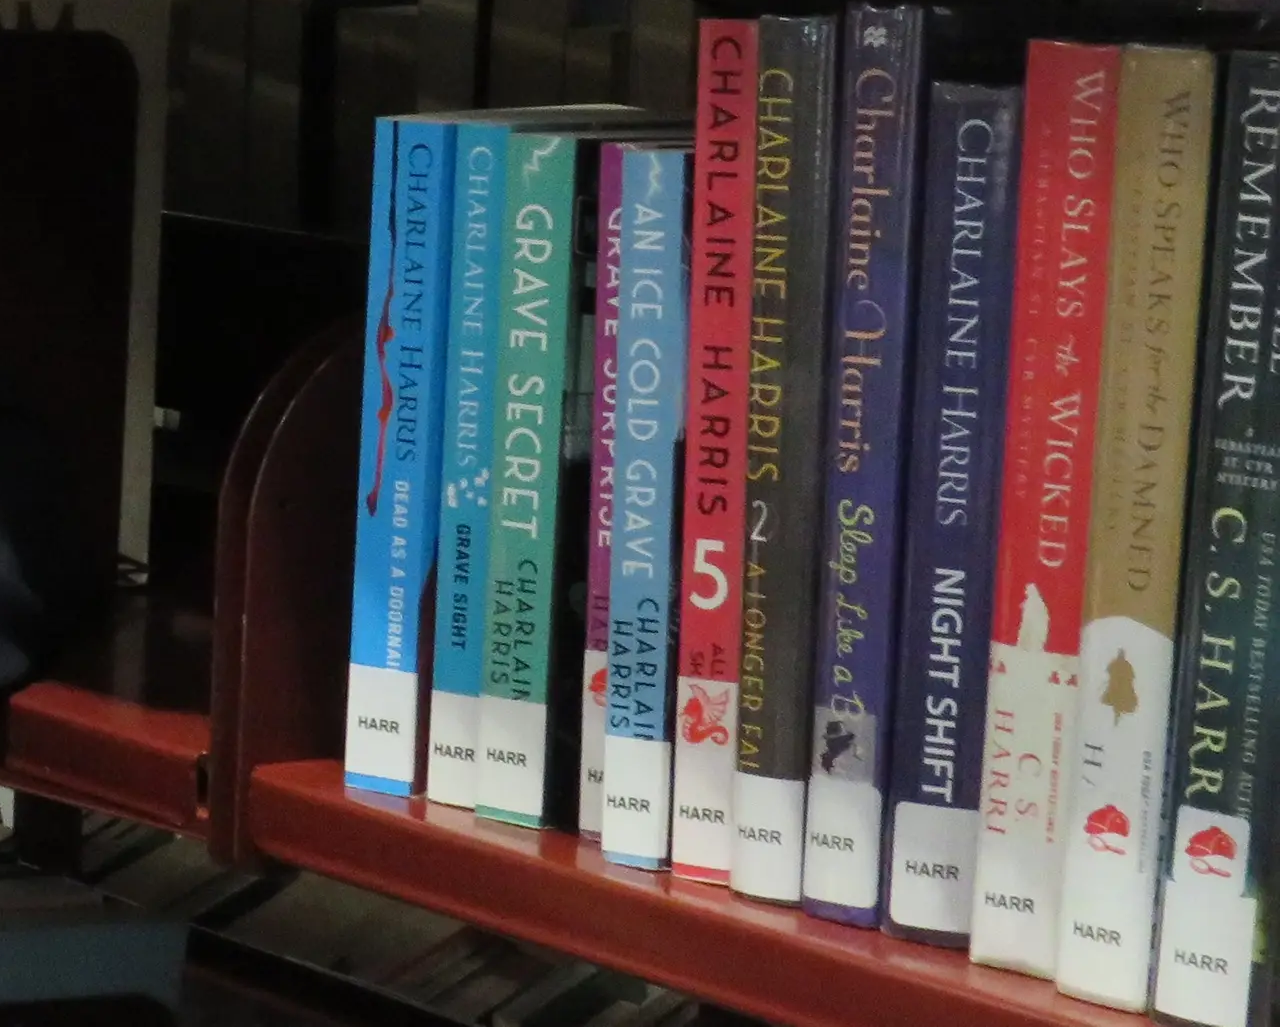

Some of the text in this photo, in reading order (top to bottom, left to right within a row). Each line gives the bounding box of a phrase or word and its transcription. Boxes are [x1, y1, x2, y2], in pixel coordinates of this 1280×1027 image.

[698, 36, 742, 515] CHARLAINE HARRIS
[747, 68, 793, 482] CHARLAINE HARRIS
[837, 68, 897, 474] Charlaine Harris
[1217, 86, 1280, 410] REMEMBER
[397, 143, 433, 462] CHARLAINE HARRIS
[457, 146, 493, 467] CHARLAINE HARRIS
[937, 119, 994, 525] CHARLAINE HARRIS
[1039, 71, 1105, 568] WHO SLAYS the WICKED
[501, 204, 553, 538] GRAVE SECRET
[1128, 91, 1191, 591] WHO SPEAKS for the DAMNED
[622, 204, 665, 579] AN ICE COLD GRAVE
[392, 480, 410, 528] DEAD
[750, 499, 768, 543] 2
[391, 535, 407, 559] AS
[391, 566, 406, 578] A
[690, 538, 728, 610] 5
[747, 561, 766, 577] A
[828, 499, 875, 585] Sleep
[1260, 530, 1276, 566] USA
[451, 524, 471, 650] GRAVE SIGHT
[1253, 573, 1272, 630] TODAY
[491, 580, 514, 684] HARRIS
[836, 591, 868, 658] Like
[611, 619, 633, 729] HARRIS
[833, 665, 853, 687] a
[921, 567, 966, 804] NIGHT SHIFT
[1242, 637, 1266, 764] BESTSELLING
[358, 715, 399, 734] HARR
[1185, 629, 1237, 799] HARR
[434, 743, 475, 762] HARR
[486, 747, 527, 767] HARR
[607, 794, 650, 813] HARR
[679, 805, 725, 824] HARR
[739, 826, 782, 845] HARR
[811, 831, 855, 852] HARR
[905, 859, 960, 881] HARR
[985, 891, 1035, 914] HARR
[1074, 922, 1121, 946] HARR
[1174, 949, 1228, 974] HARR
